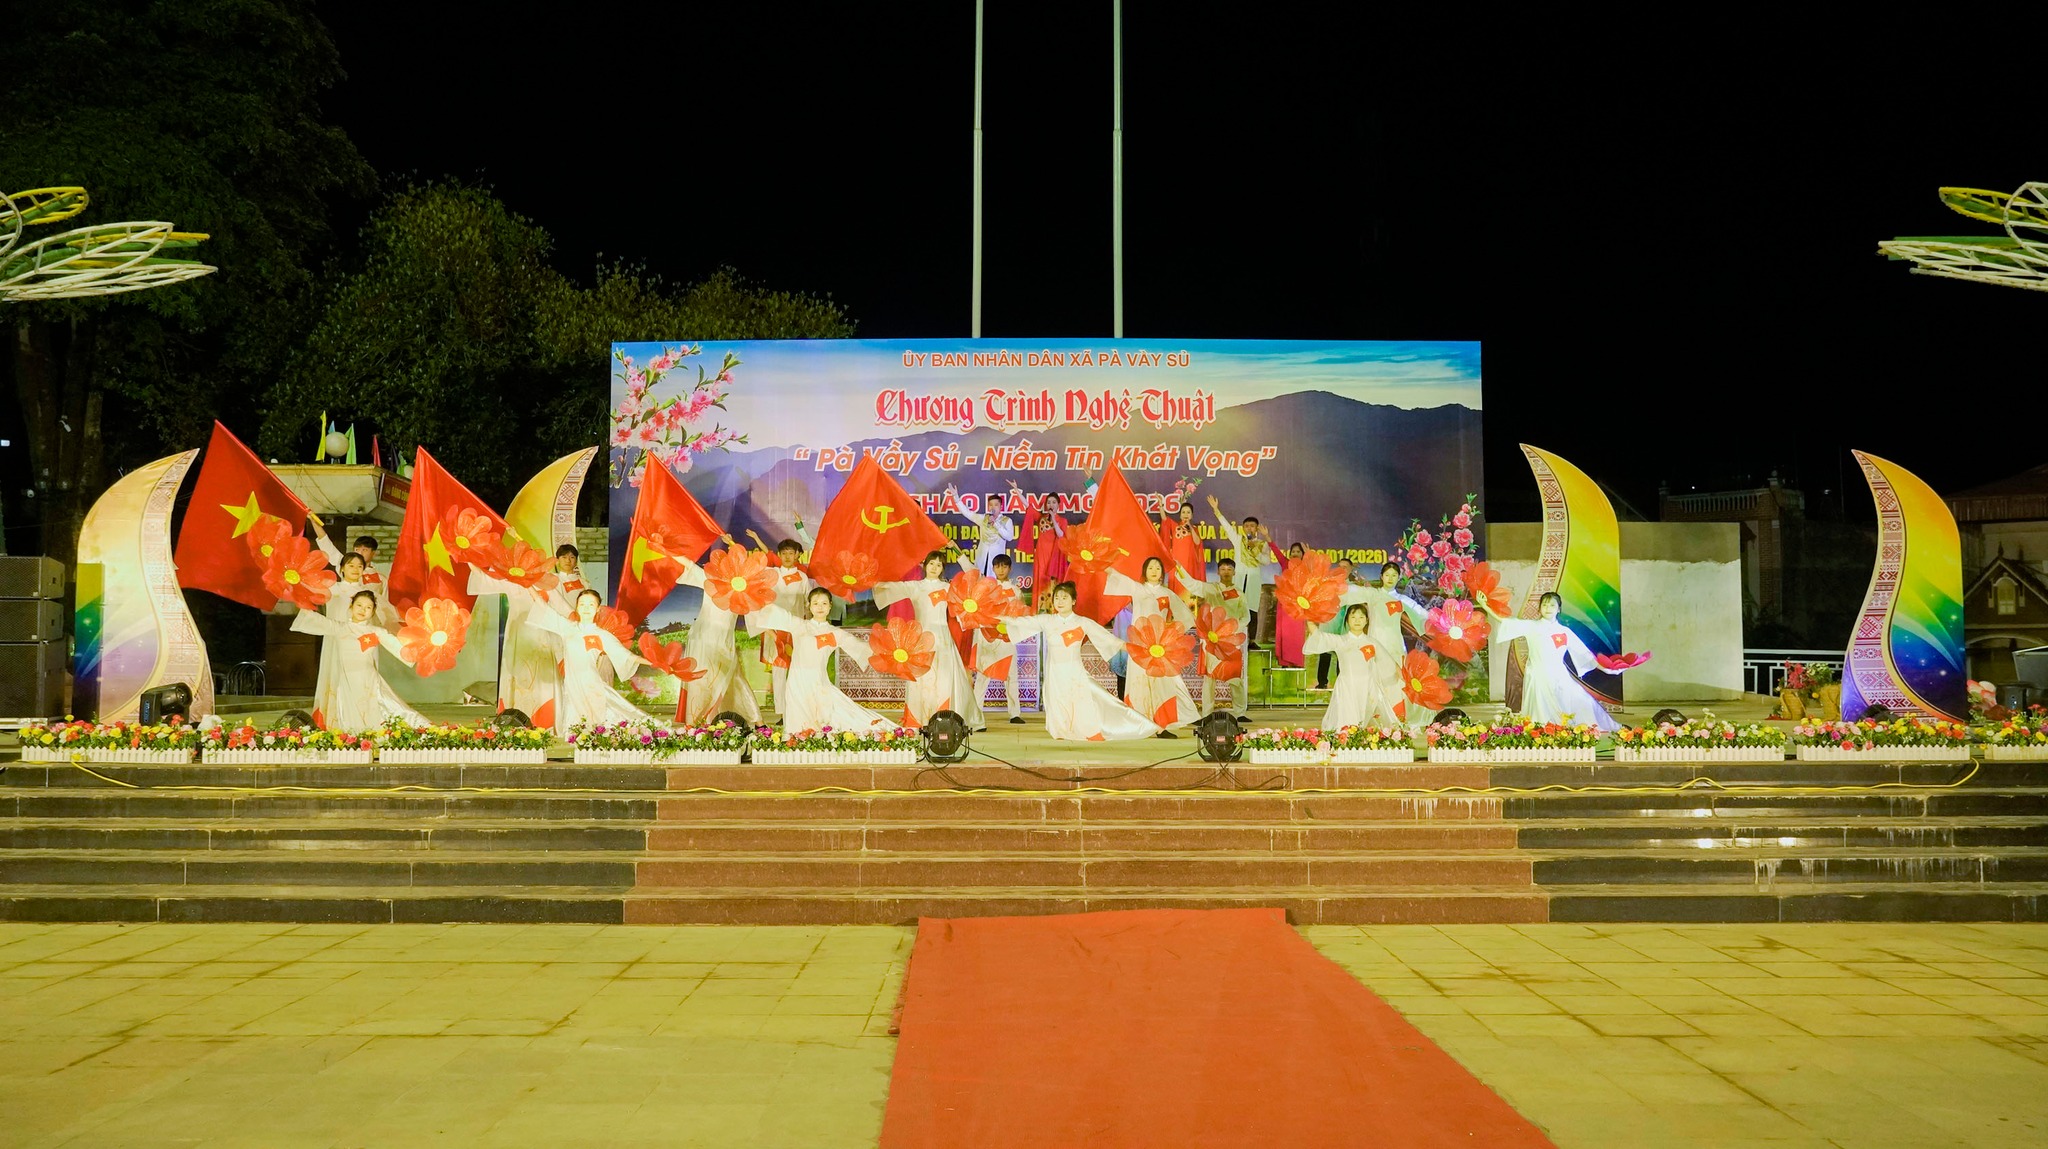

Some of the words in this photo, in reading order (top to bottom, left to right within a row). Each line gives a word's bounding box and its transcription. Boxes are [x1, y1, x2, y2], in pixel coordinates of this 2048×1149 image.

[902, 349, 928, 368] ỦY
[930, 352, 969, 368] BAN
[973, 349, 1023, 368] NHÂN
[1027, 349, 1065, 368] DÂN
[1069, 349, 1094, 368] XÃ
[1098, 349, 1123, 368] PÀ
[1166, 349, 1191, 368] SỦ
[875, 388, 976, 432] Chương
[981, 388, 1056, 431] Trình
[1064, 388, 1131, 431] Nghệ
[1138, 388, 1216, 431] Thuật
[924, 442, 961, 471] Sủ
[964, 456, 979, 465] -
[981, 438, 1058, 471] Niềm
[1064, 445, 1105, 471] Tin
[1112, 442, 1180, 471] Khát
